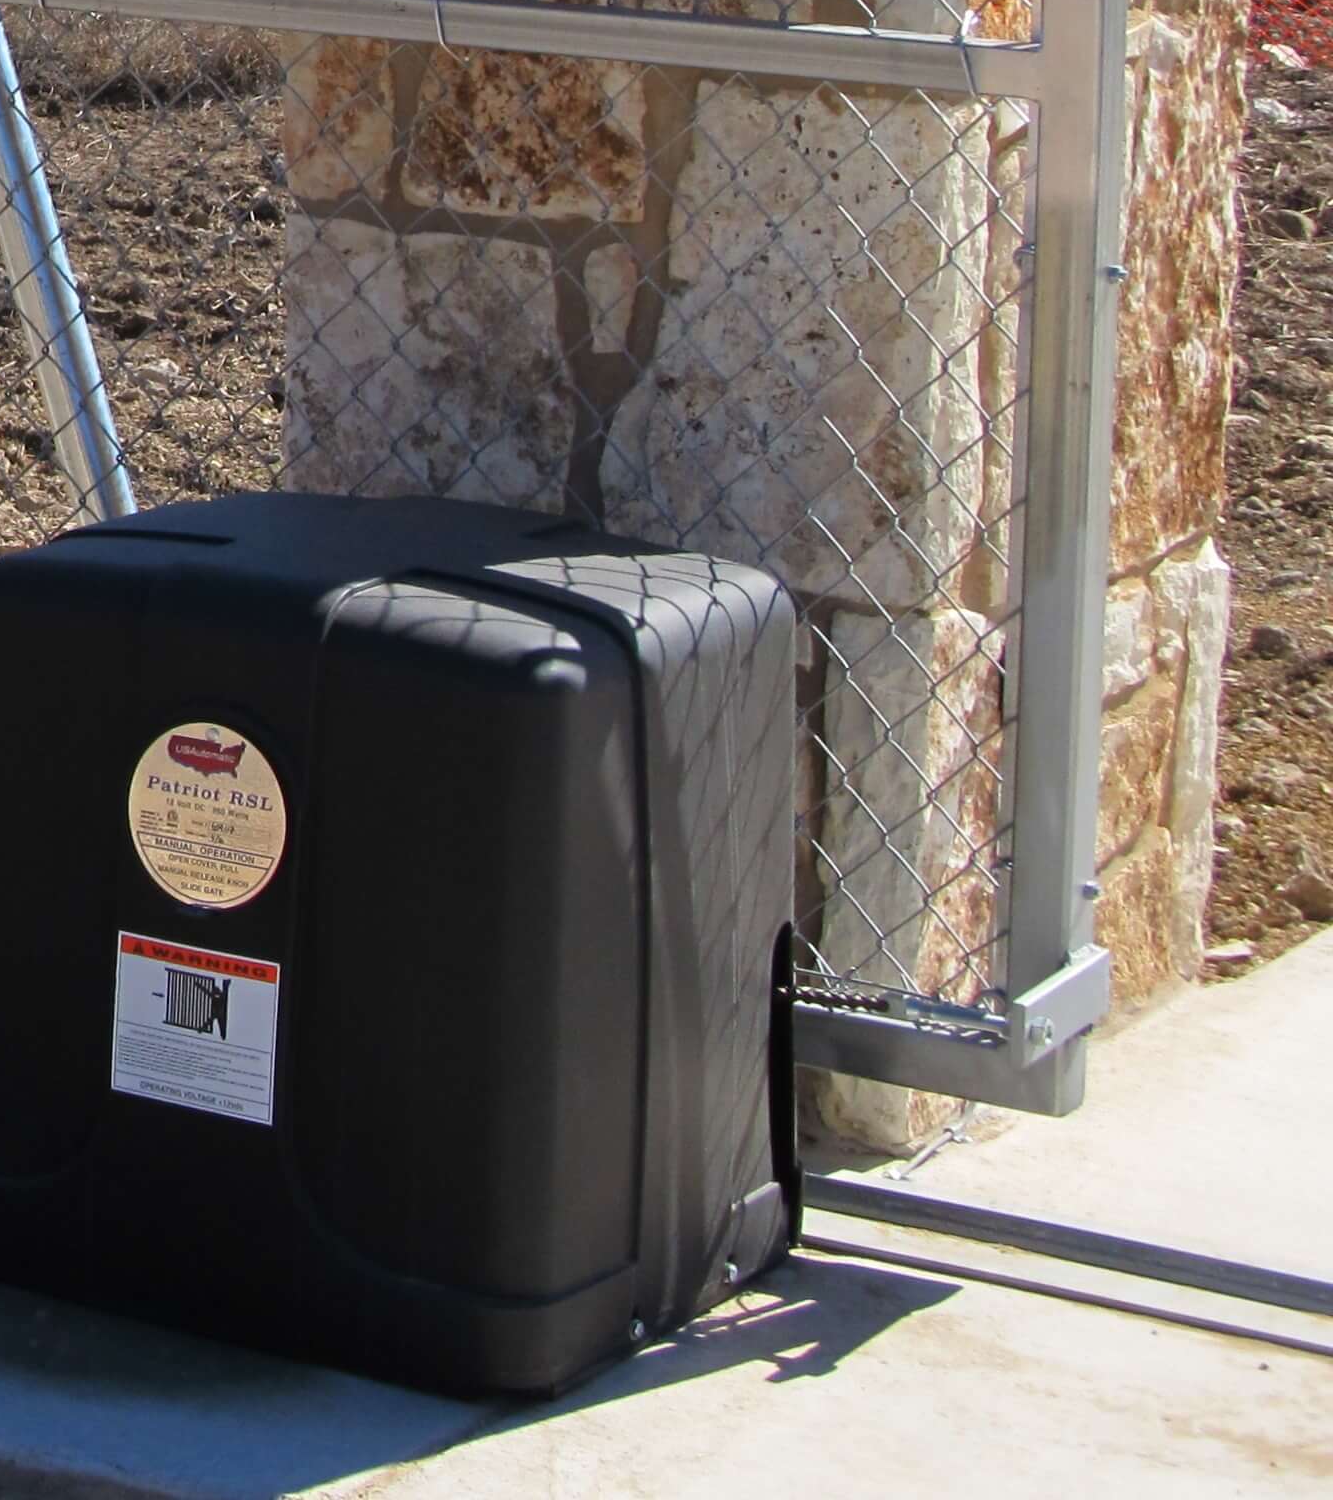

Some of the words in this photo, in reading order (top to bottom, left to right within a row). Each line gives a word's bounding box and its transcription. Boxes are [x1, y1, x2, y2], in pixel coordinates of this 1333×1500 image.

[175, 744, 236, 764] USAutomatic
[146, 775, 222, 802] Patriot
[229, 789, 273, 812] RSL
[195, 803, 205, 812] DC
[155, 838, 193, 852] MANUAL
[200, 847, 255, 864] OPERATION
[168, 853, 189, 865] OPEN
[220, 862, 239, 874] PULL
[158, 865, 188, 878] MANUAL
[190, 870, 224, 885] RELEASE
[180, 881, 202, 892] SLIDE
[204, 886, 223, 897] GATE
[152, 946, 268, 979] WARNING
[139, 1081, 182, 1098] OPERATING
[183, 1090, 217, 1105] VOLTAGE
